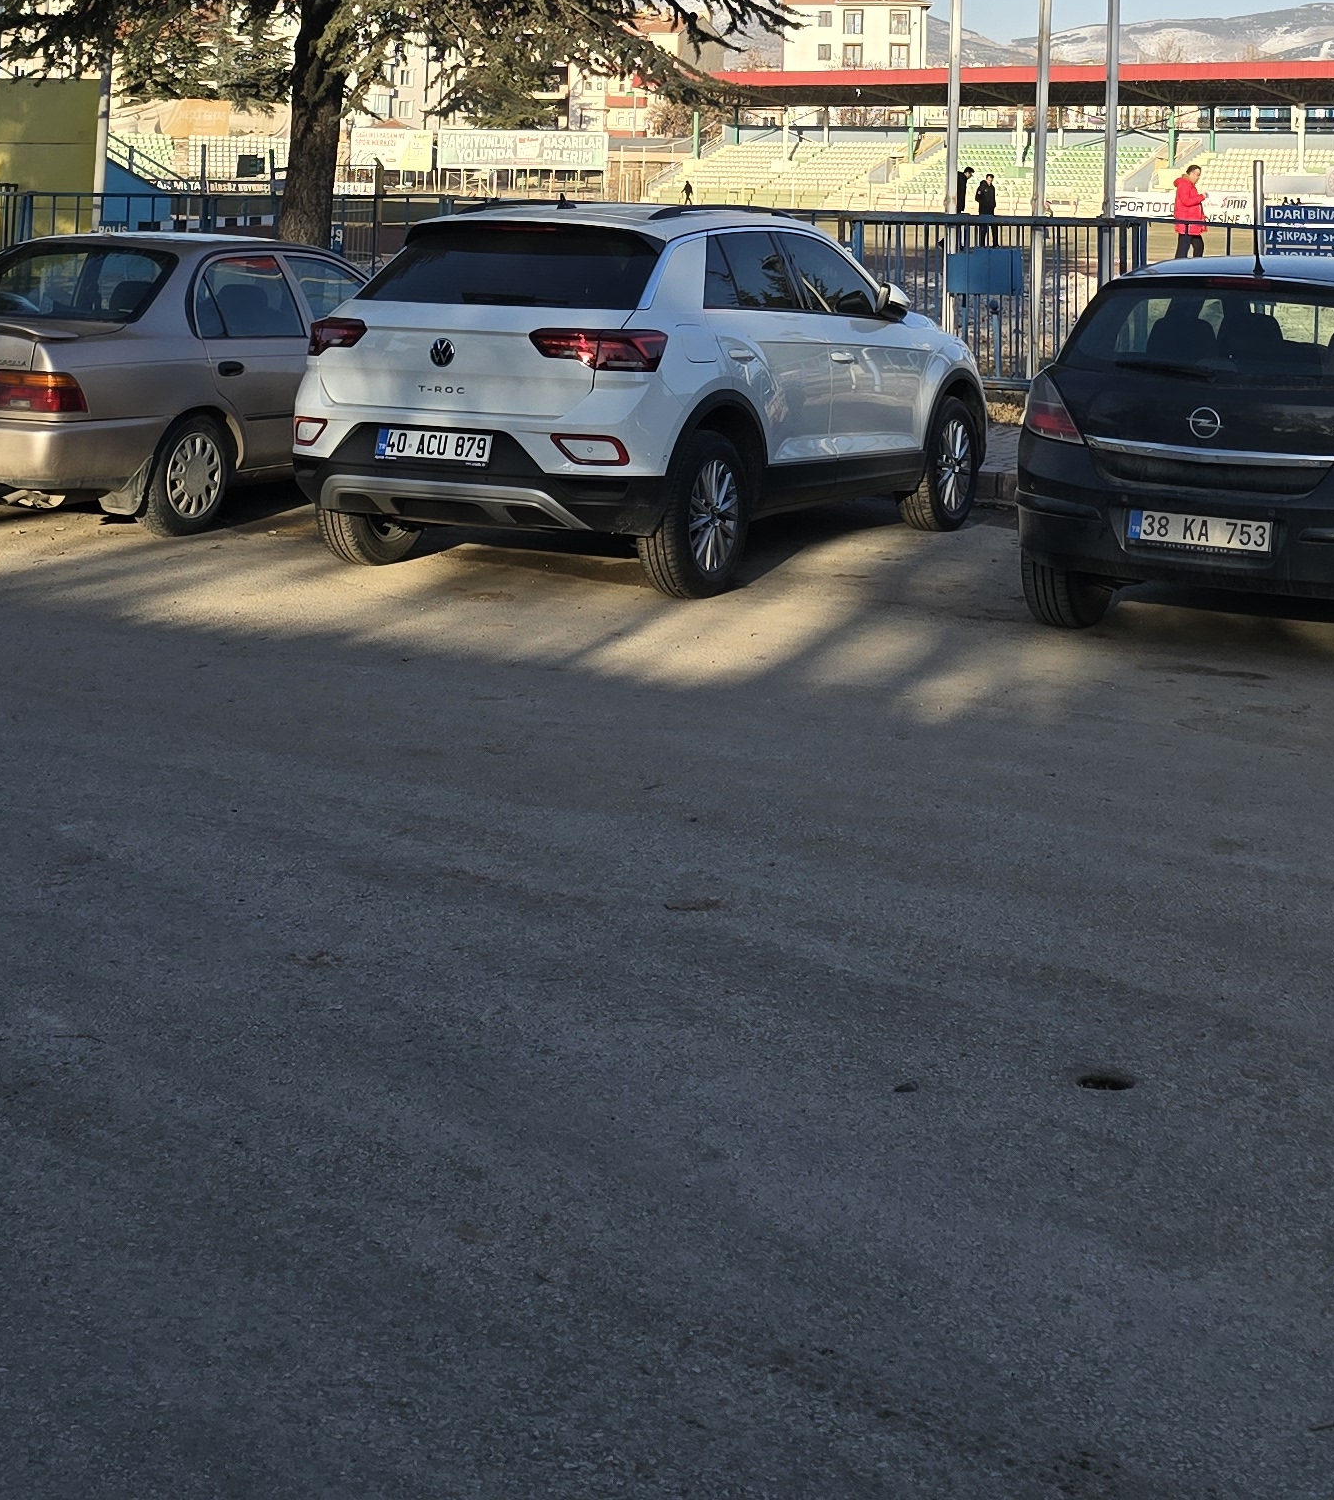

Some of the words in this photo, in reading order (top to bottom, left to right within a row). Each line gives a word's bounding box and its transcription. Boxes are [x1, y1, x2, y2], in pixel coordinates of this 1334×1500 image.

[543, 136, 603, 150] BAŞARILAR
[456, 148, 515, 163] YOLUNDA
[1269, 207, 1305, 220] İDARİ
[418, 384, 465, 395] T-ROC
[386, 431, 408, 453] 40
[415, 433, 449, 456] ACU
[454, 436, 487, 459] 879
[1131, 525, 1141, 534] TR
[1142, 514, 1170, 538] 38
[1182, 517, 1209, 543] KA
[1225, 521, 1267, 548] 753
